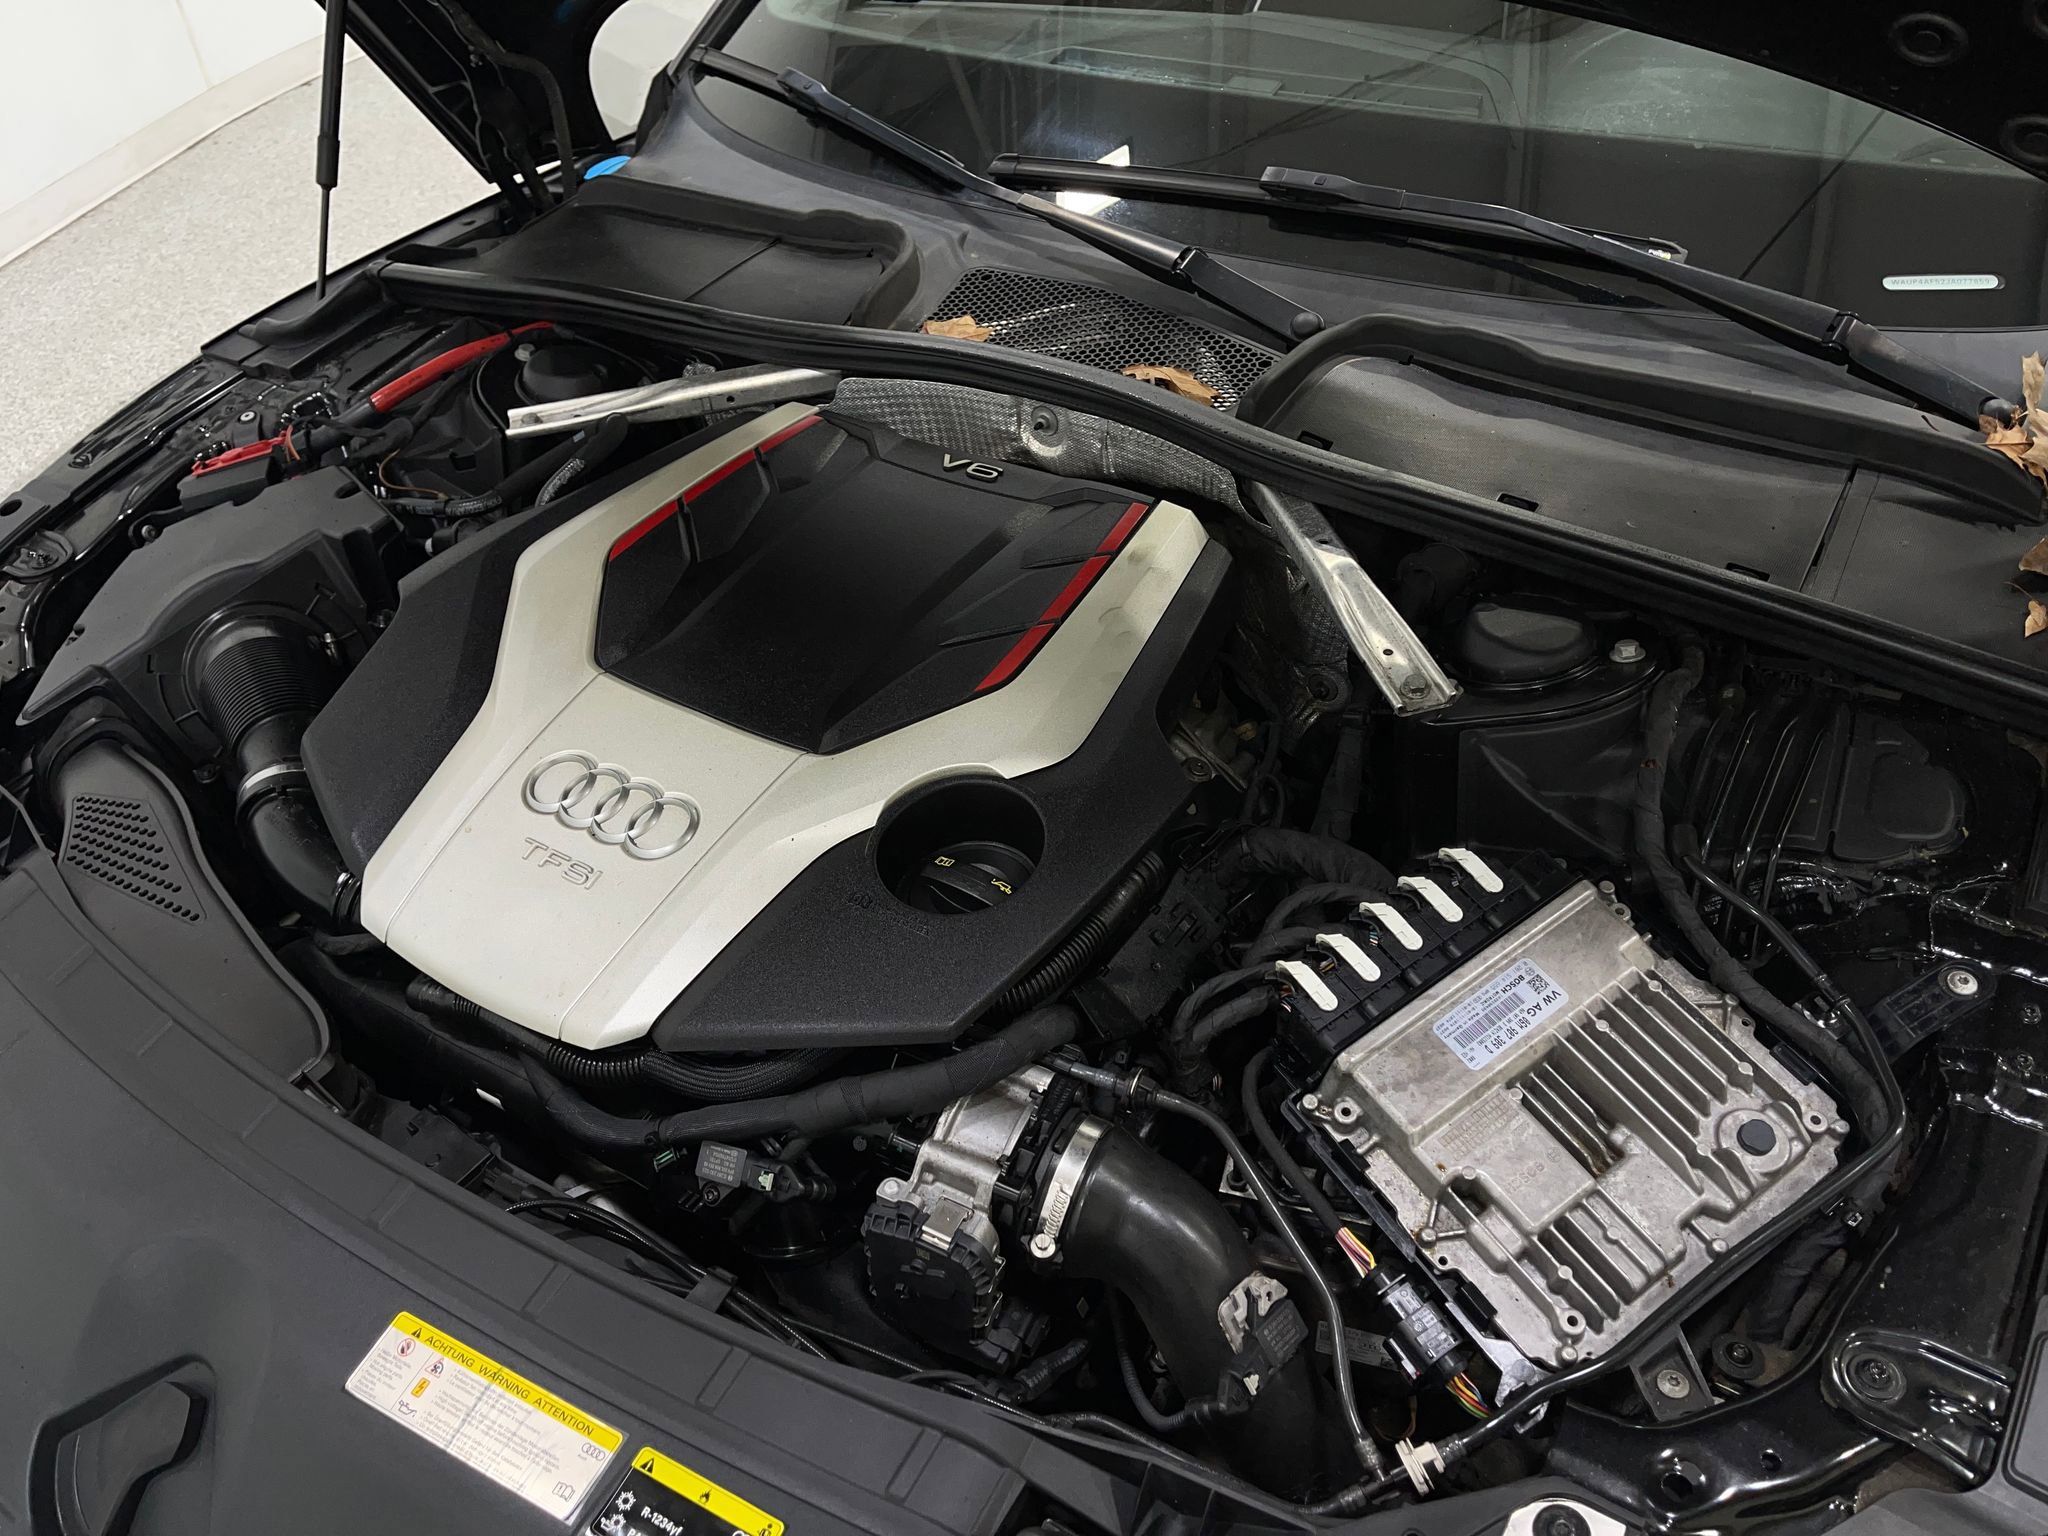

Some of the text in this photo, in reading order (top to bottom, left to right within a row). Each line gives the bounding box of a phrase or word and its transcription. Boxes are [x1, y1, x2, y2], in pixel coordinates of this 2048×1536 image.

[943, 453, 1003, 482] V6
[521, 836, 604, 890] TFSI
[1501, 974, 1525, 994] BOSCH
[1543, 990, 1561, 1006] VW
[1524, 1002, 1542, 1017] AG
[1491, 1035, 1506, 1049] 309
[1504, 1026, 1519, 1040] 907
[1484, 1045, 1494, 1054] D
[426, 1335, 476, 1368] ACHTUNG
[479, 1363, 531, 1399] WARNING
[534, 1397, 594, 1435] ATTENTION
[640, 1506, 684, 1536] R-1234yf
